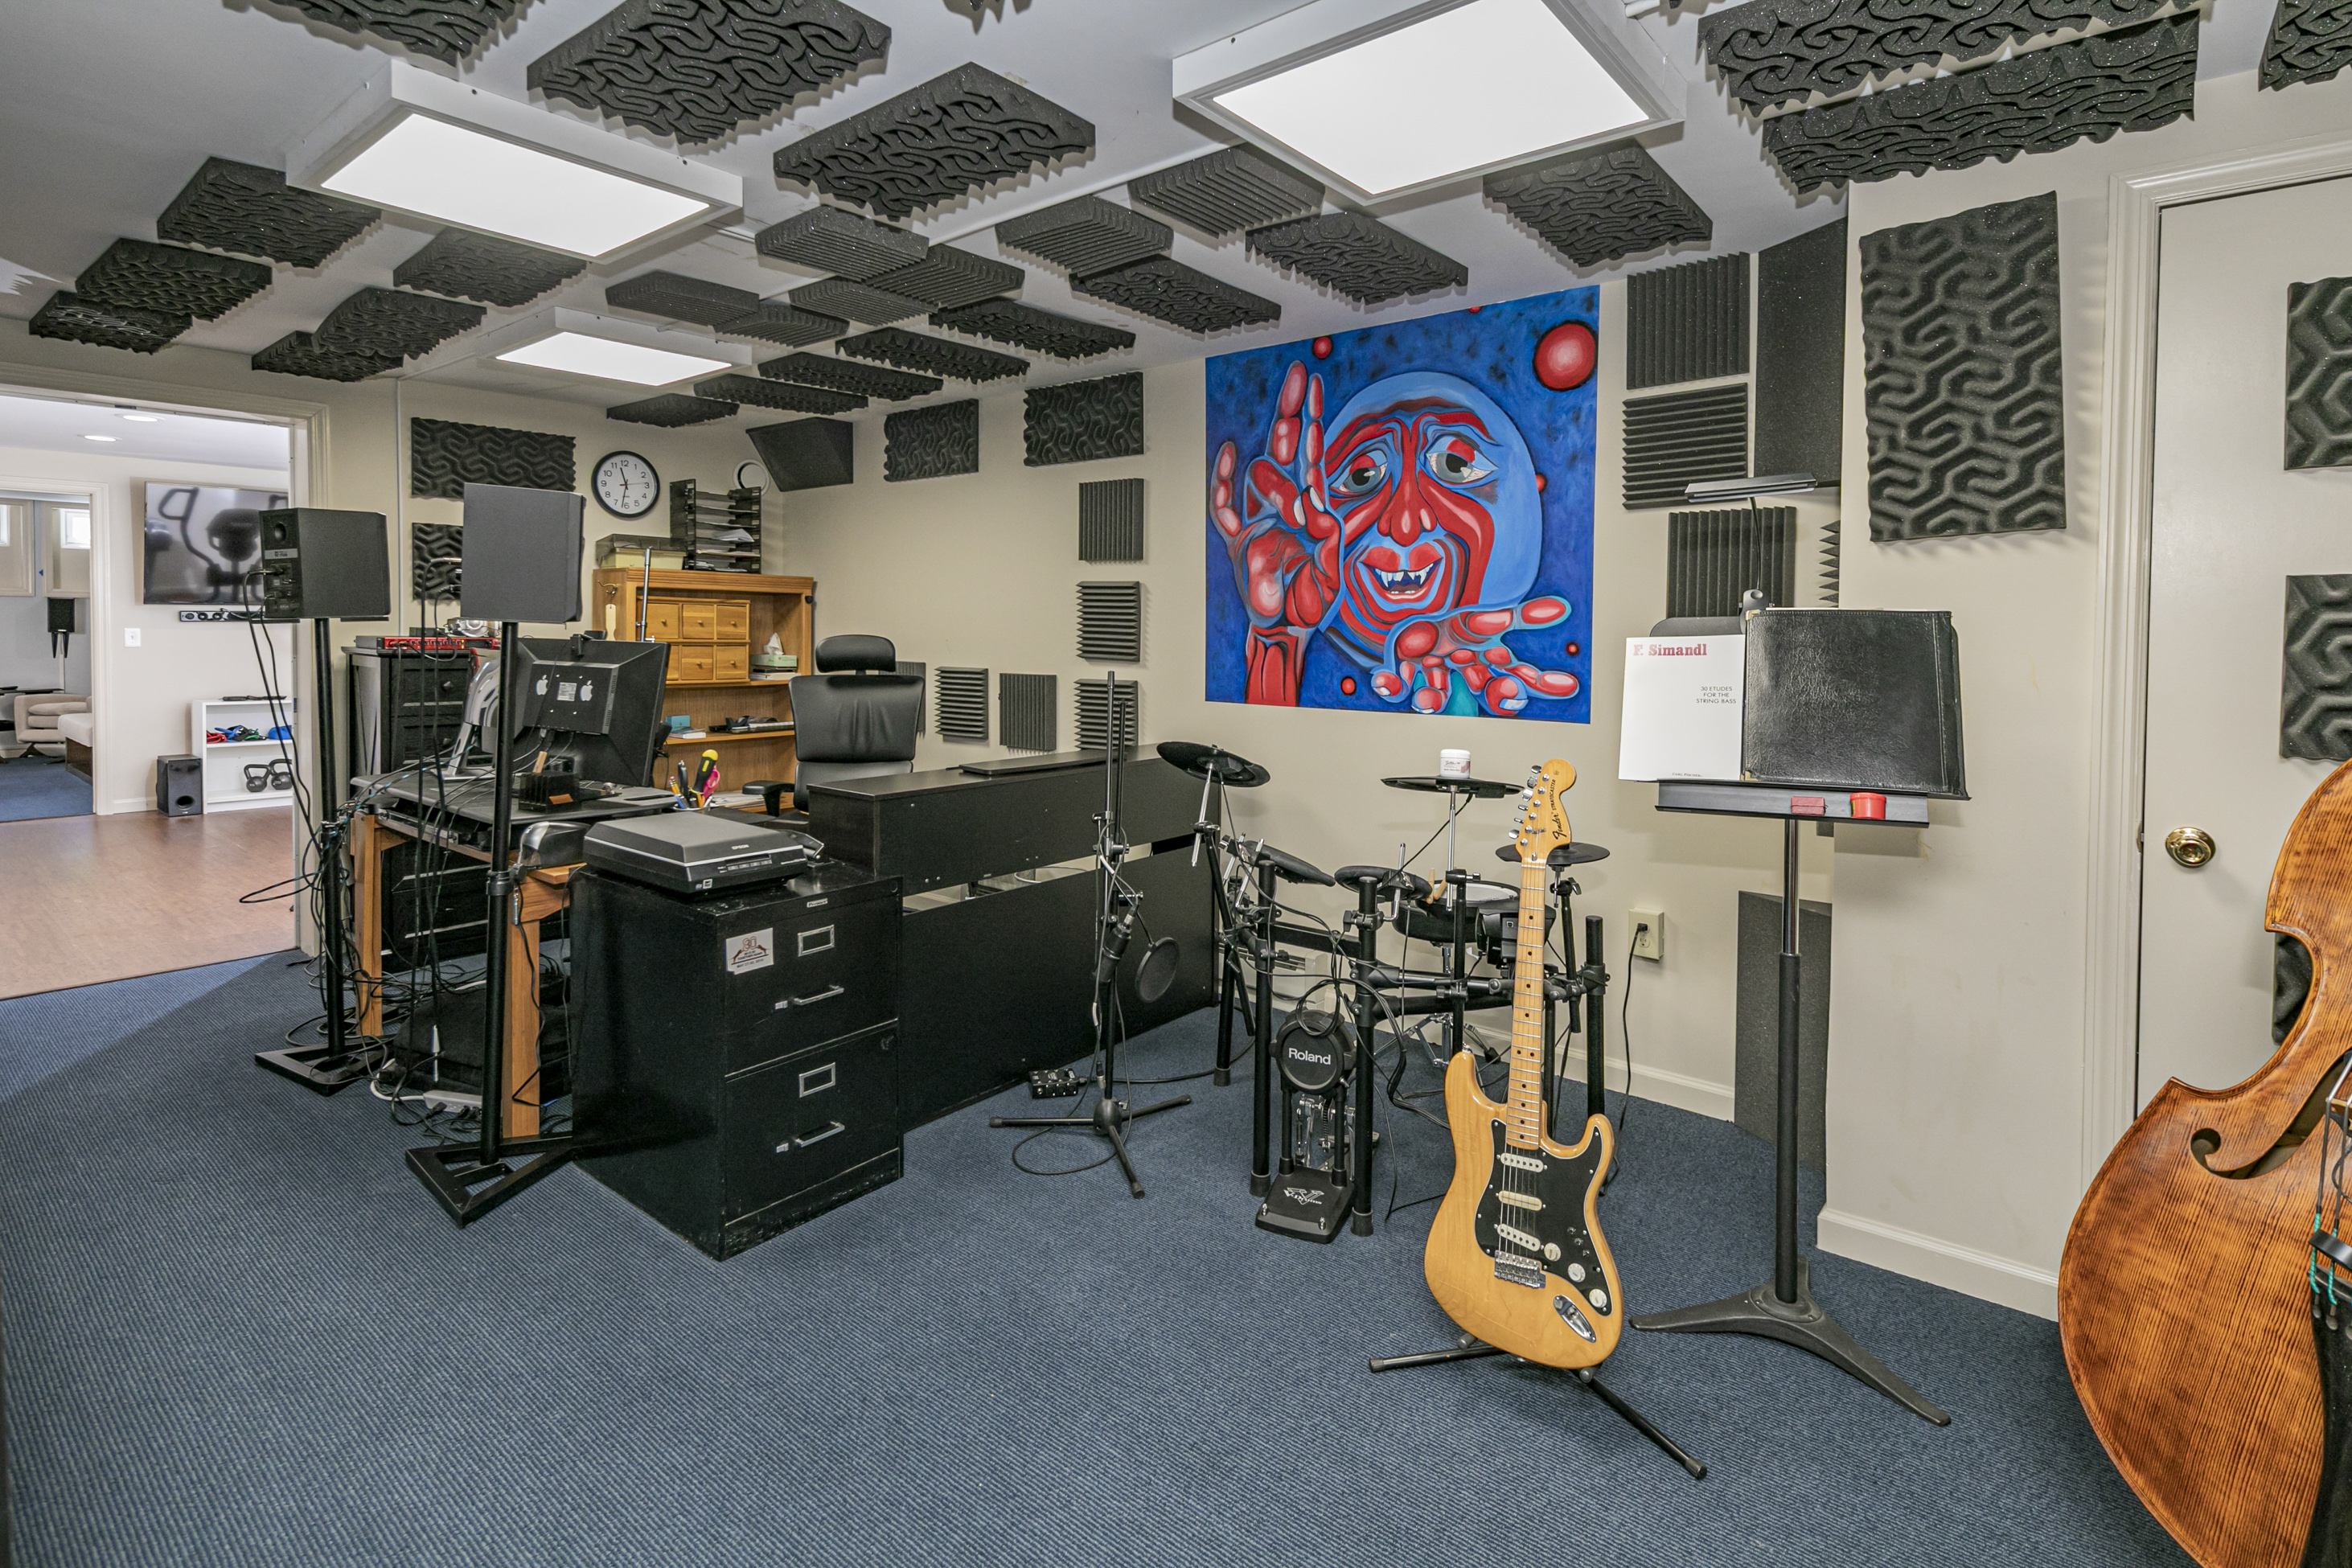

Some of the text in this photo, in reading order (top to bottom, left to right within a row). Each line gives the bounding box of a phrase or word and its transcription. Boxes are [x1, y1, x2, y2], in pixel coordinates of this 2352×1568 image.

[1648, 643, 1708, 656] Simandl
[1549, 778, 1567, 840] Fender STRATOCASTER
[1288, 1047, 1332, 1065] Roland
